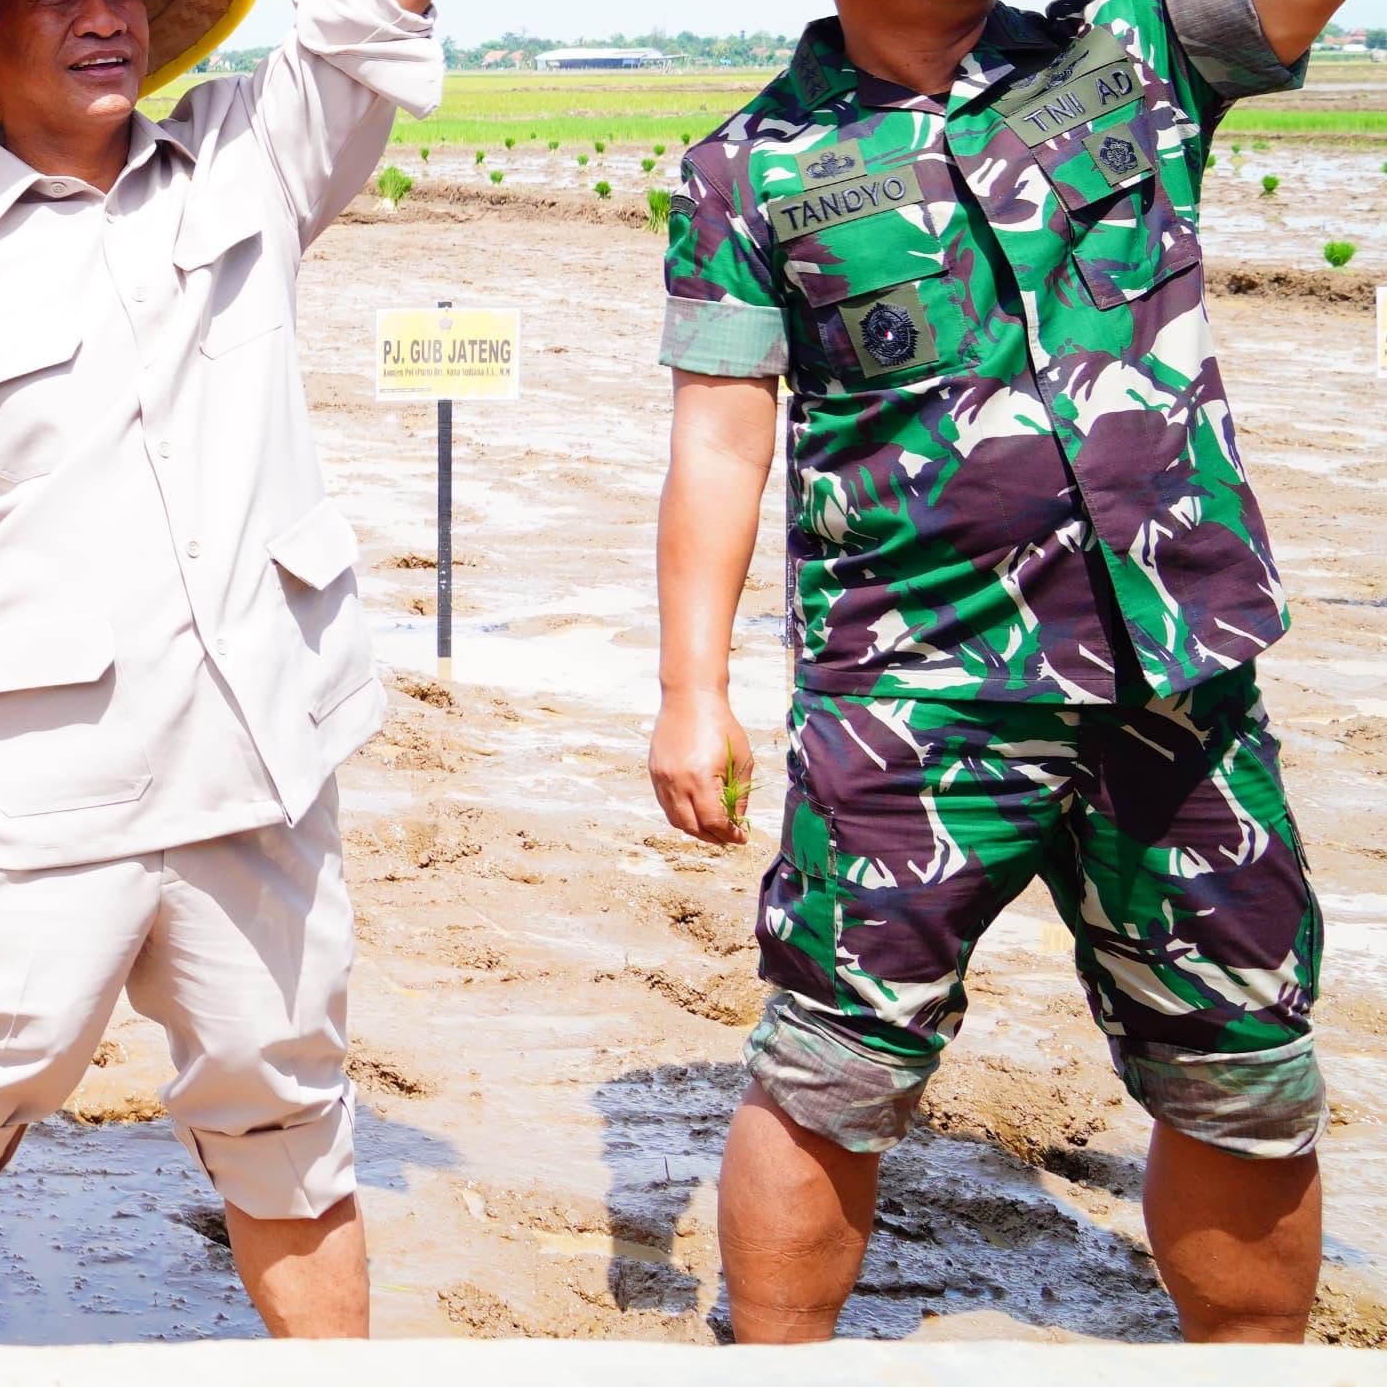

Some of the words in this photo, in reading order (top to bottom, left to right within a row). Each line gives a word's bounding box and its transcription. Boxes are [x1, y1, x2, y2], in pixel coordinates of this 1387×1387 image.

[1022, 89, 1085, 134] TNI
[1095, 67, 1135, 106] AD
[780, 176, 908, 232] TANDYO
[383, 339, 405, 365] PJ.
[410, 339, 443, 364] GUB
[447, 339, 512, 364] JATENG
